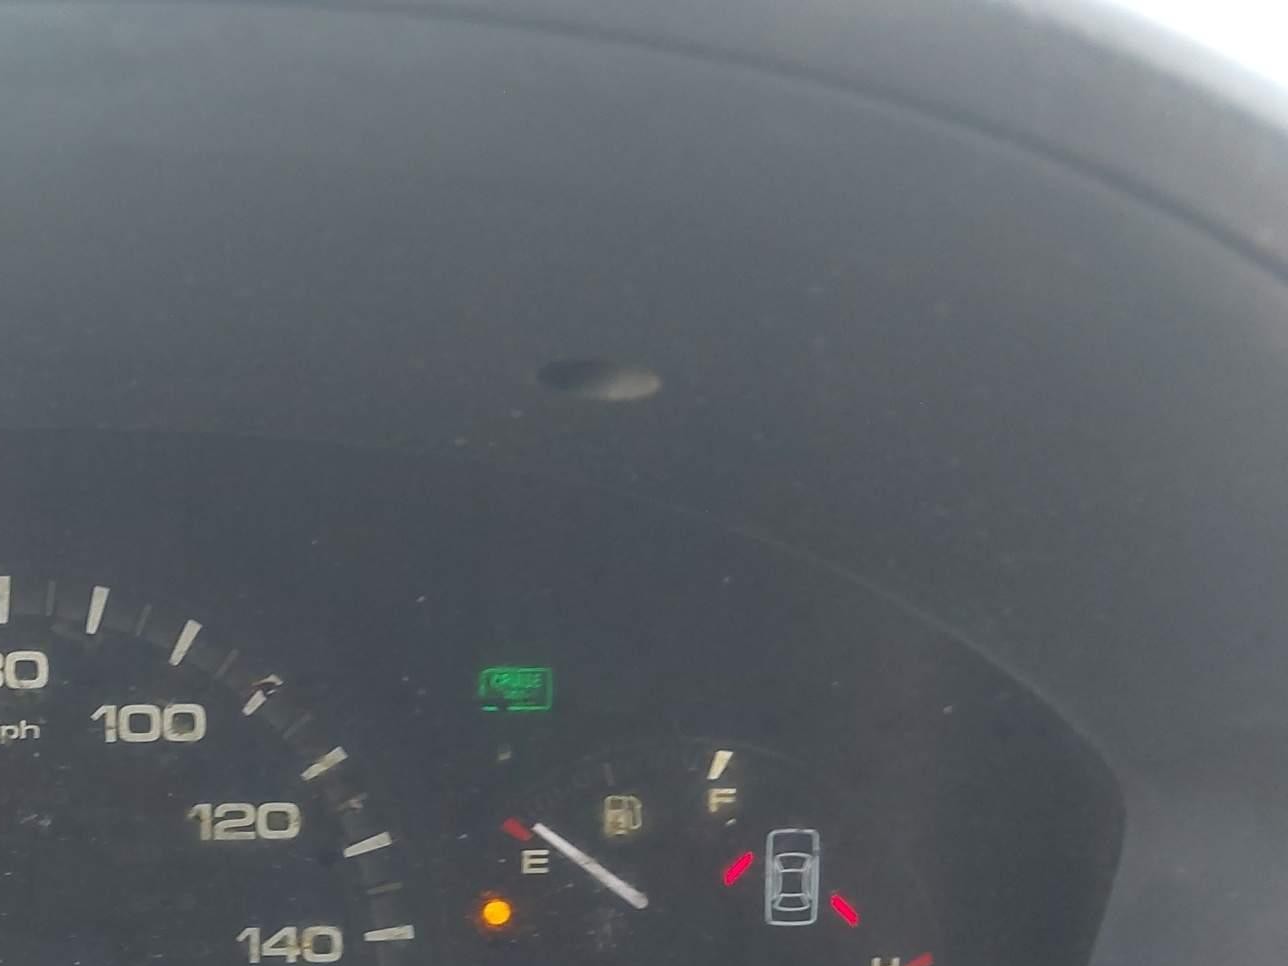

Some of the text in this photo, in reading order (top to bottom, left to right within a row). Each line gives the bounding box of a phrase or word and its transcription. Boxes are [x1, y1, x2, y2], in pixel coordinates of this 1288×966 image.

[90, 703, 207, 743] 100
[709, 788, 737, 812] F
[189, 802, 302, 842] 120
[522, 849, 549, 874] E
[236, 924, 343, 963] 140
